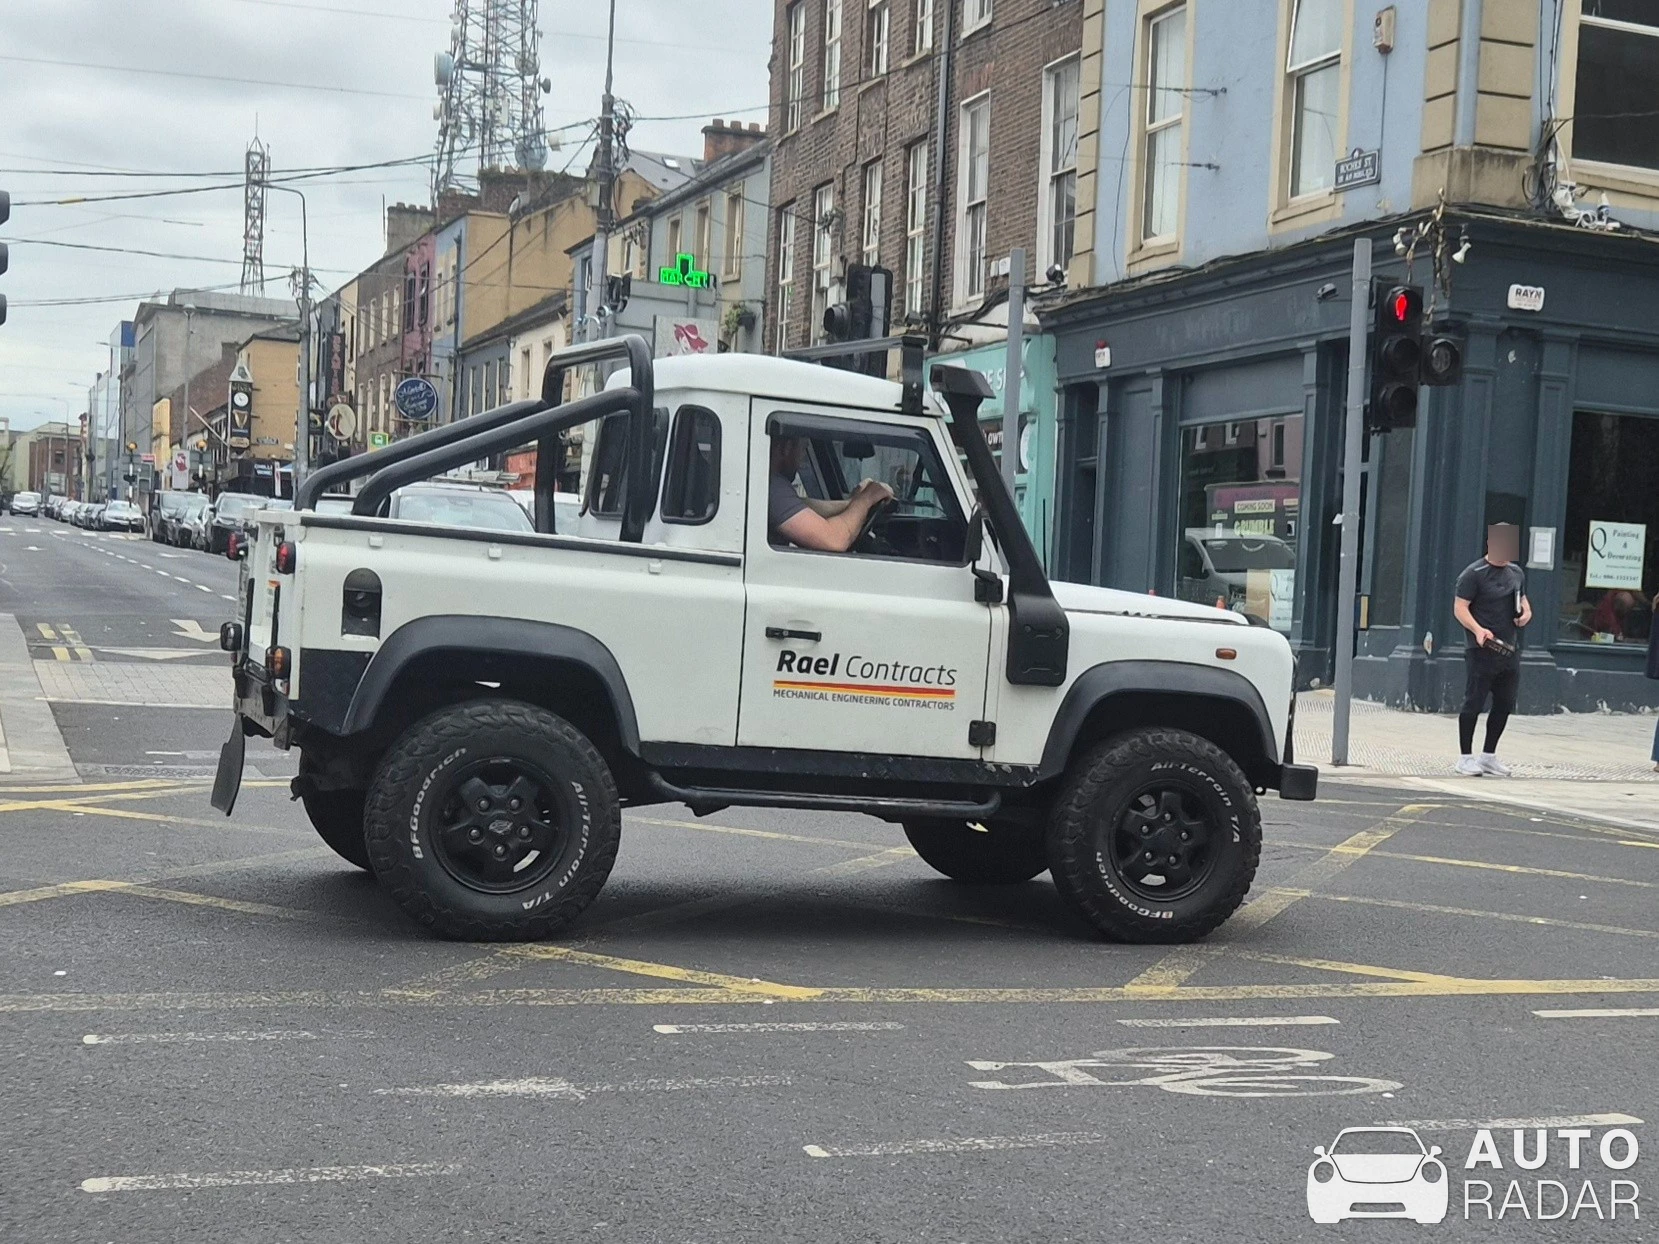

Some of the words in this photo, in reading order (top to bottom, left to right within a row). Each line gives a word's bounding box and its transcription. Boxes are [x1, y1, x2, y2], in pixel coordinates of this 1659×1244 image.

[1590, 527, 1606, 559] Q
[1612, 529, 1640, 540] Painting
[1607, 551, 1642, 562] Decorating
[776, 650, 840, 676] Rael
[845, 656, 957, 686] Contracts
[773, 689, 829, 702] MECHANICAL
[831, 694, 891, 706] ENGINEERING
[892, 699, 955, 711] CONTRACTORS
[410, 748, 467, 859] BFGoodrich
[1096, 852, 1174, 919] BFGoodrich
